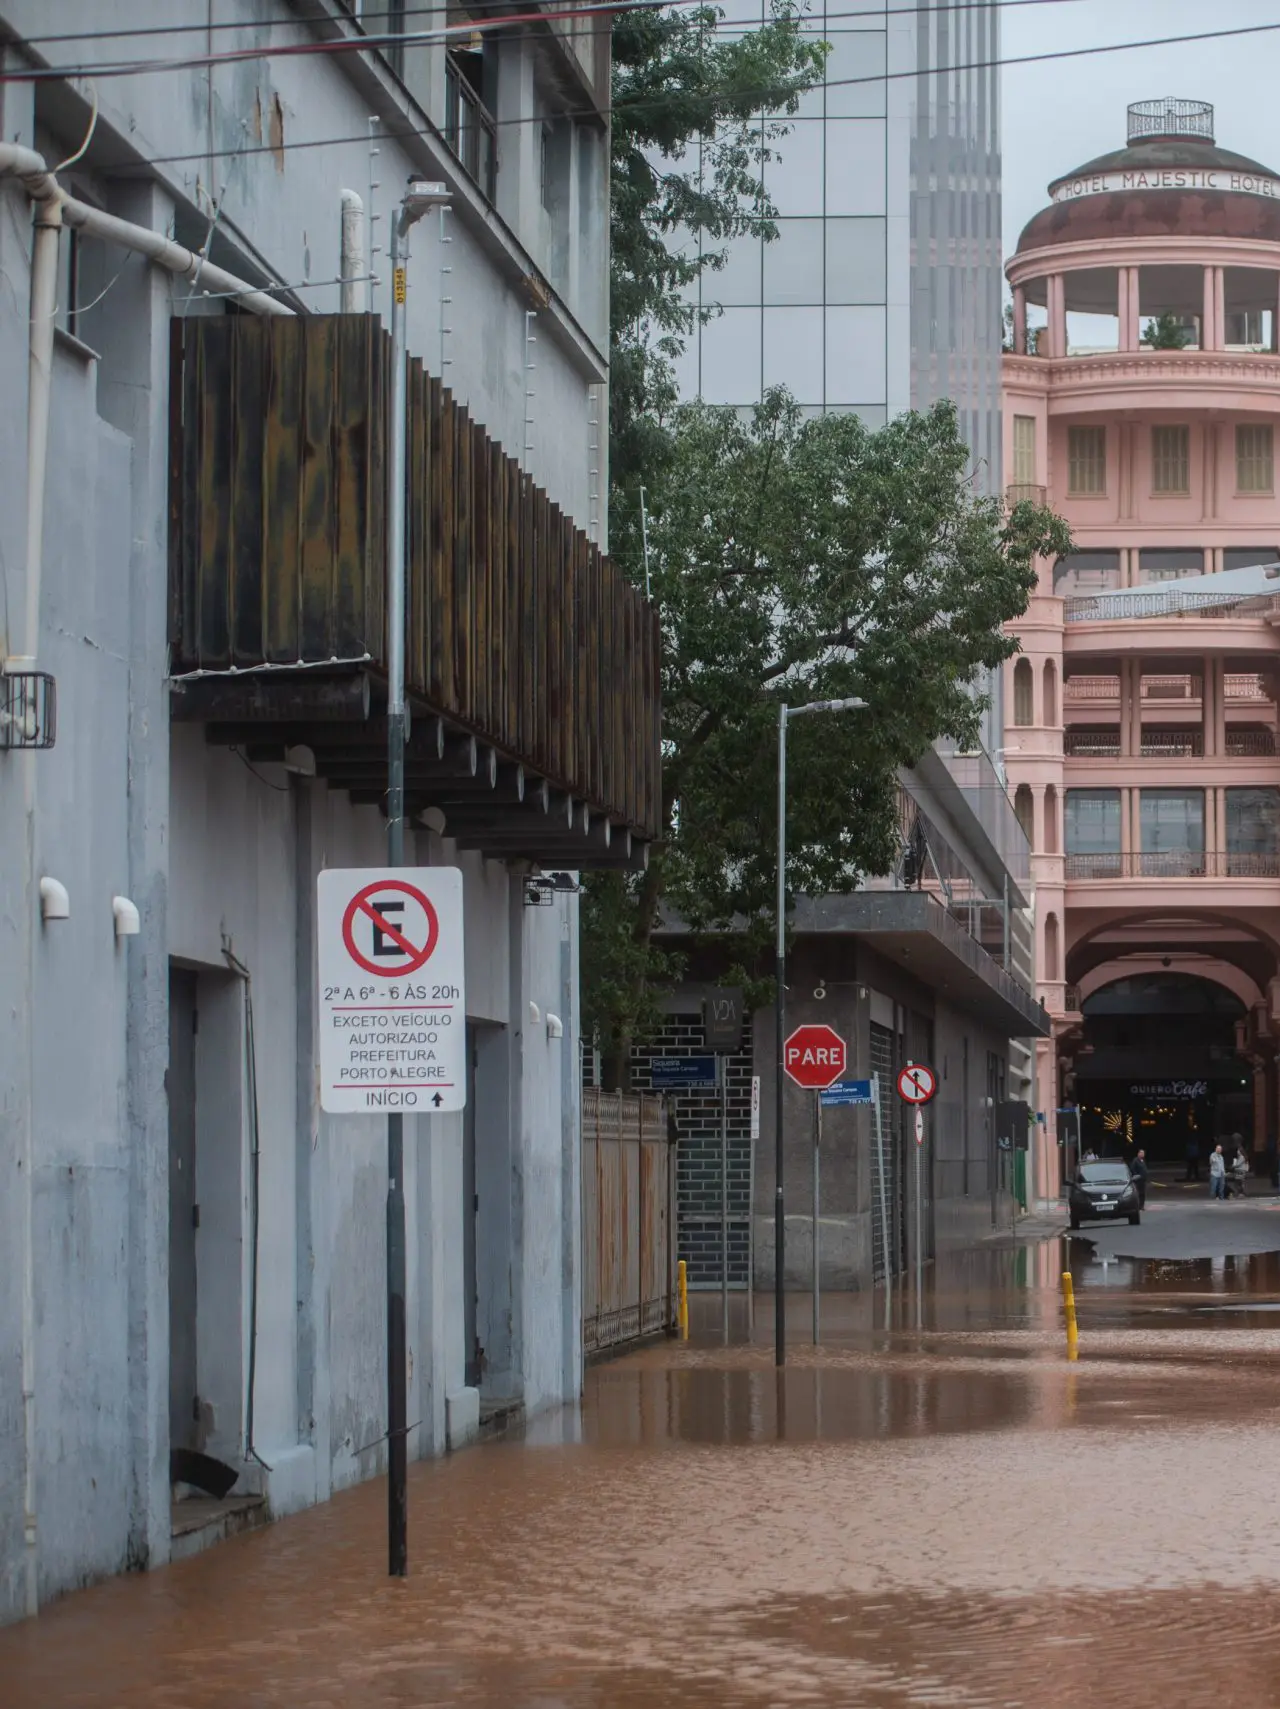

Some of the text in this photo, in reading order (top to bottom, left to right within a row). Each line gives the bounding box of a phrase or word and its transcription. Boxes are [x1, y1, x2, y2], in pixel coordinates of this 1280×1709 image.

[1066, 176, 1109, 197] HOTEL
[1122, 172, 1217, 188] MAJESTIC
[1230, 175, 1278, 196] HOTEL
[344, 987, 355, 1000] A
[390, 987, 400, 1000] 6
[405, 983, 427, 1000] ÀS
[432, 985, 460, 1000] 20h
[333, 1013, 452, 1028] EXCETO VEÍCULO
[349, 1032, 438, 1045] AUTORIZADO
[350, 1050, 436, 1061] PREFEITURA
[652, 1059, 680, 1067] Siqueira
[788, 1048, 841, 1066] PARE
[340, 1066, 446, 1079] PORTO ALEGRE
[366, 1089, 418, 1106] INÍCIO
[1130, 1080, 1208, 1099] QUIERO Café
